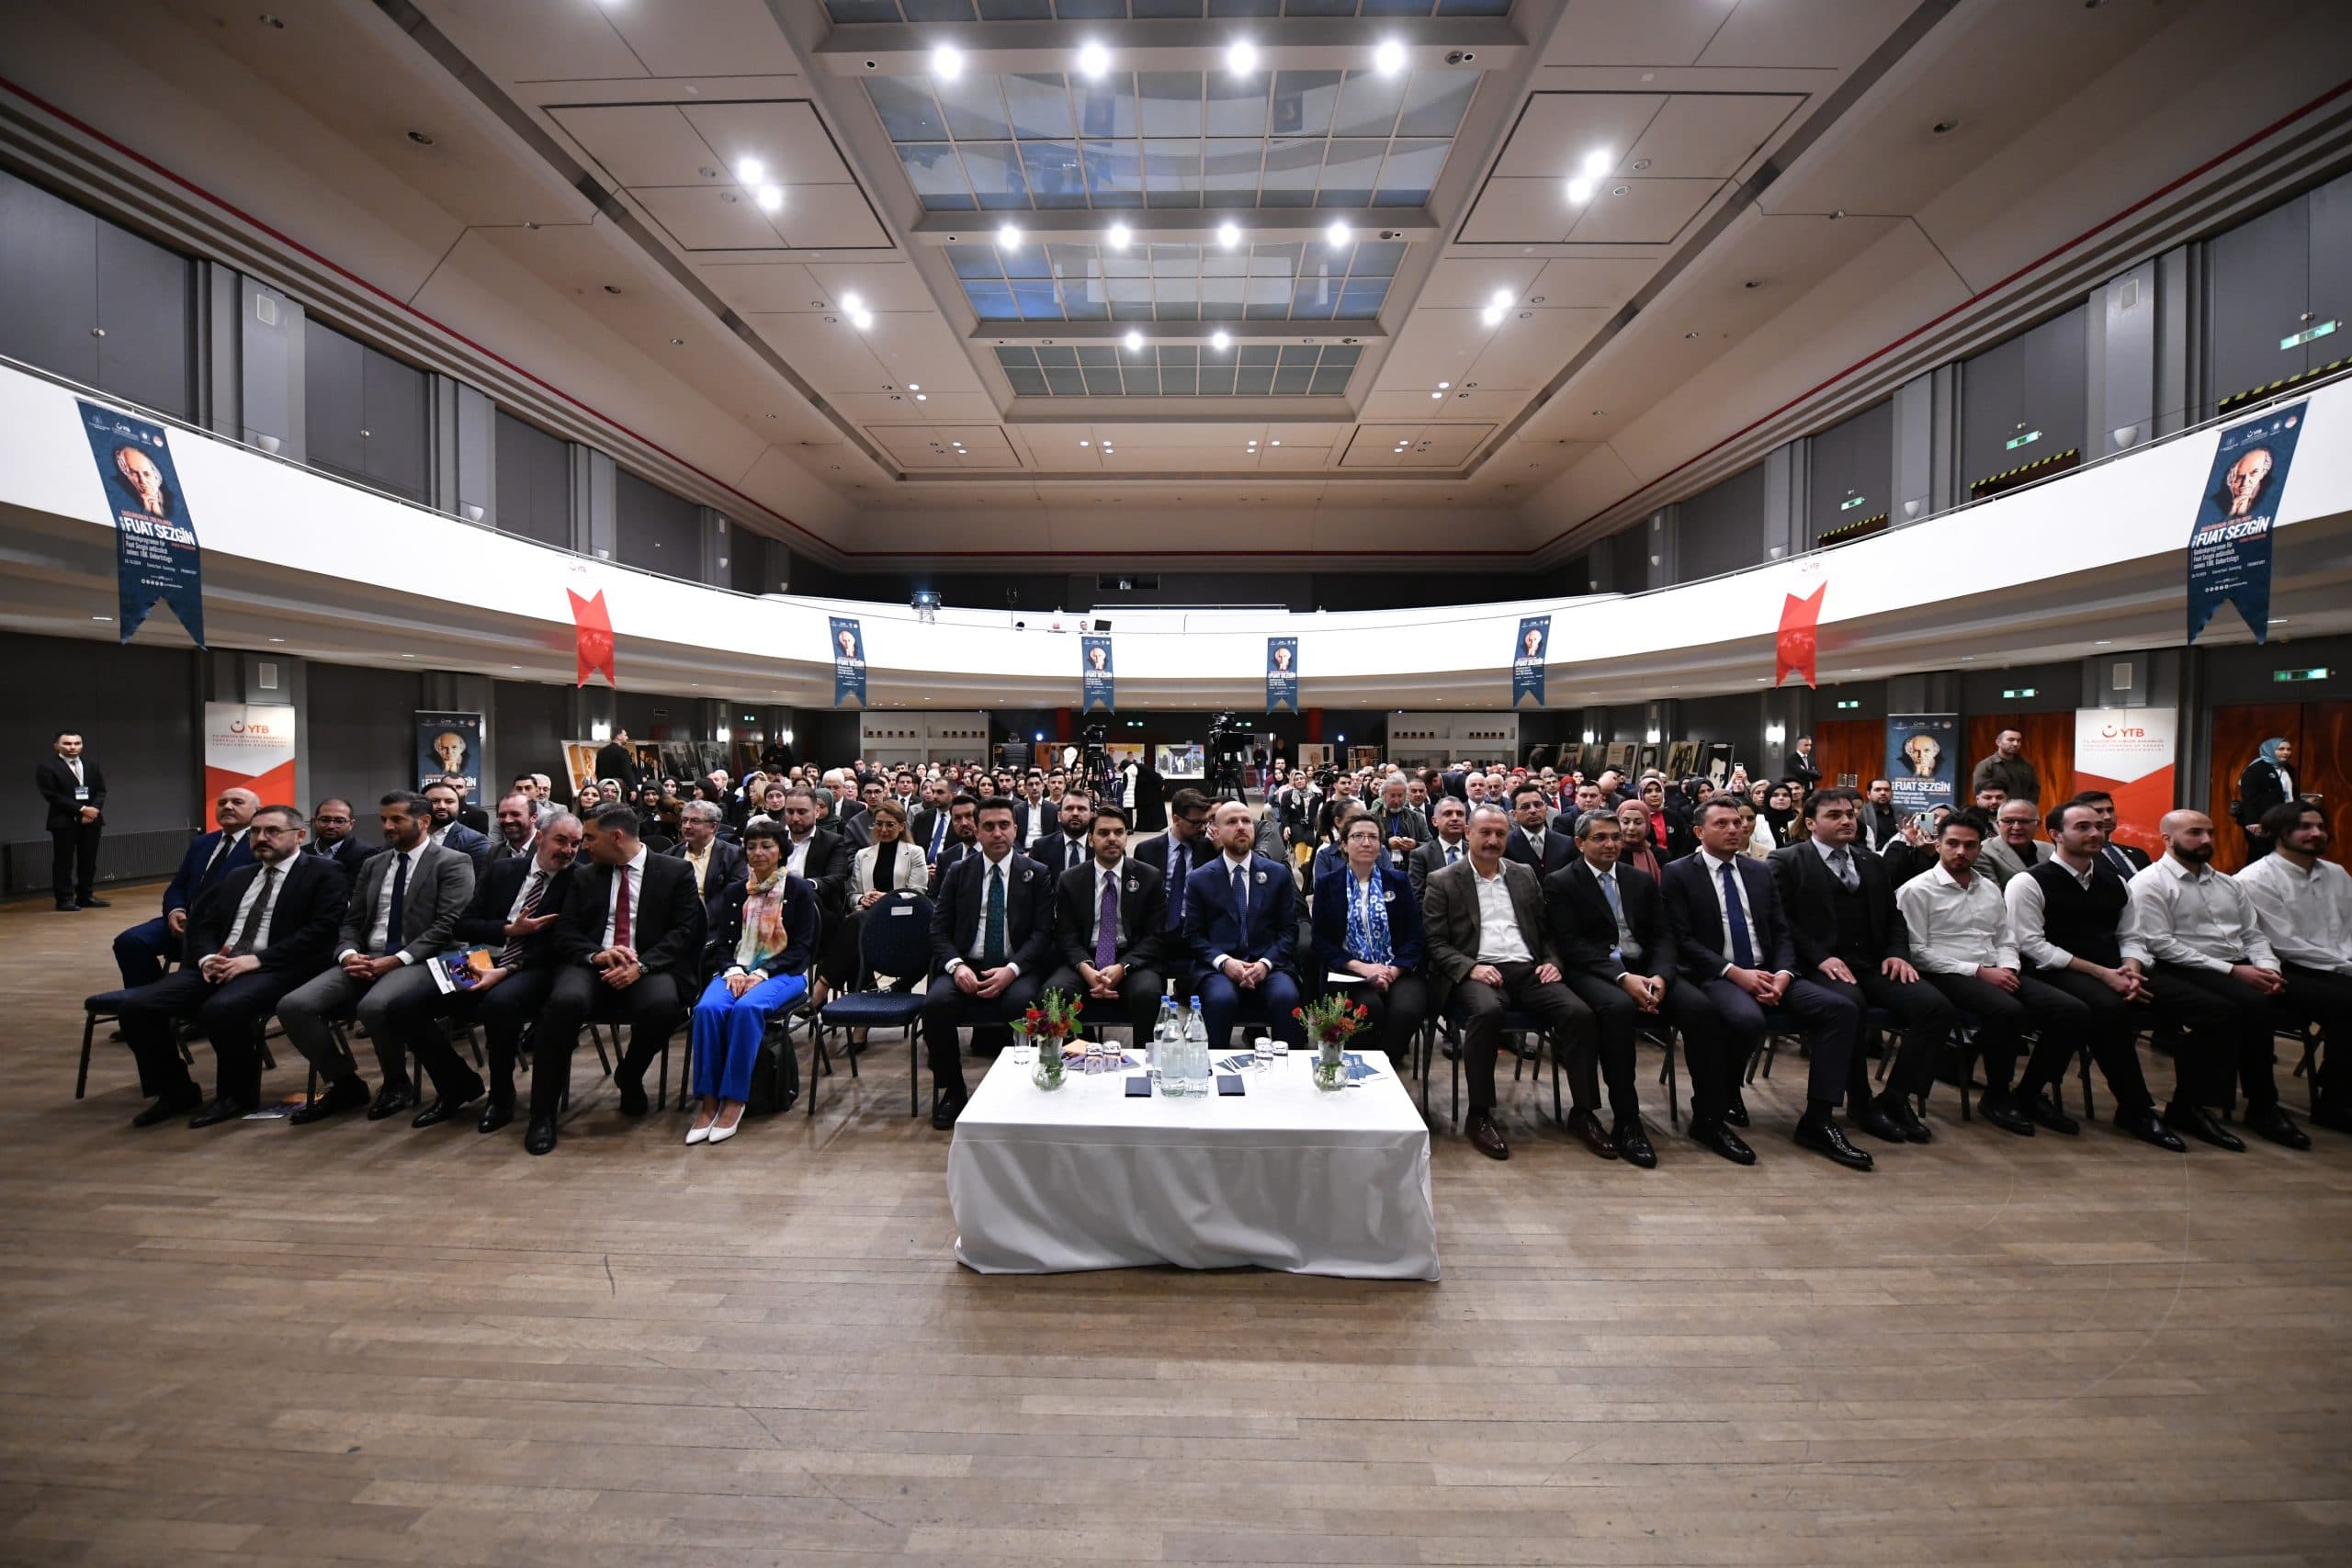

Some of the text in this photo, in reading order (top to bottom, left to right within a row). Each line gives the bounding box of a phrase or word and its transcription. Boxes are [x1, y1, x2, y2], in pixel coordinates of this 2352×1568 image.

[123, 516, 154, 536] FUAT
[154, 523, 196, 546] SEZGİN
[2197, 526, 2226, 547] FUAT
[2225, 516, 2270, 540] SEZGİN
[248, 725, 269, 734] YTB
[2120, 728, 2145, 738] YTB
[1894, 781, 1951, 792] FUAT SEZGİN
